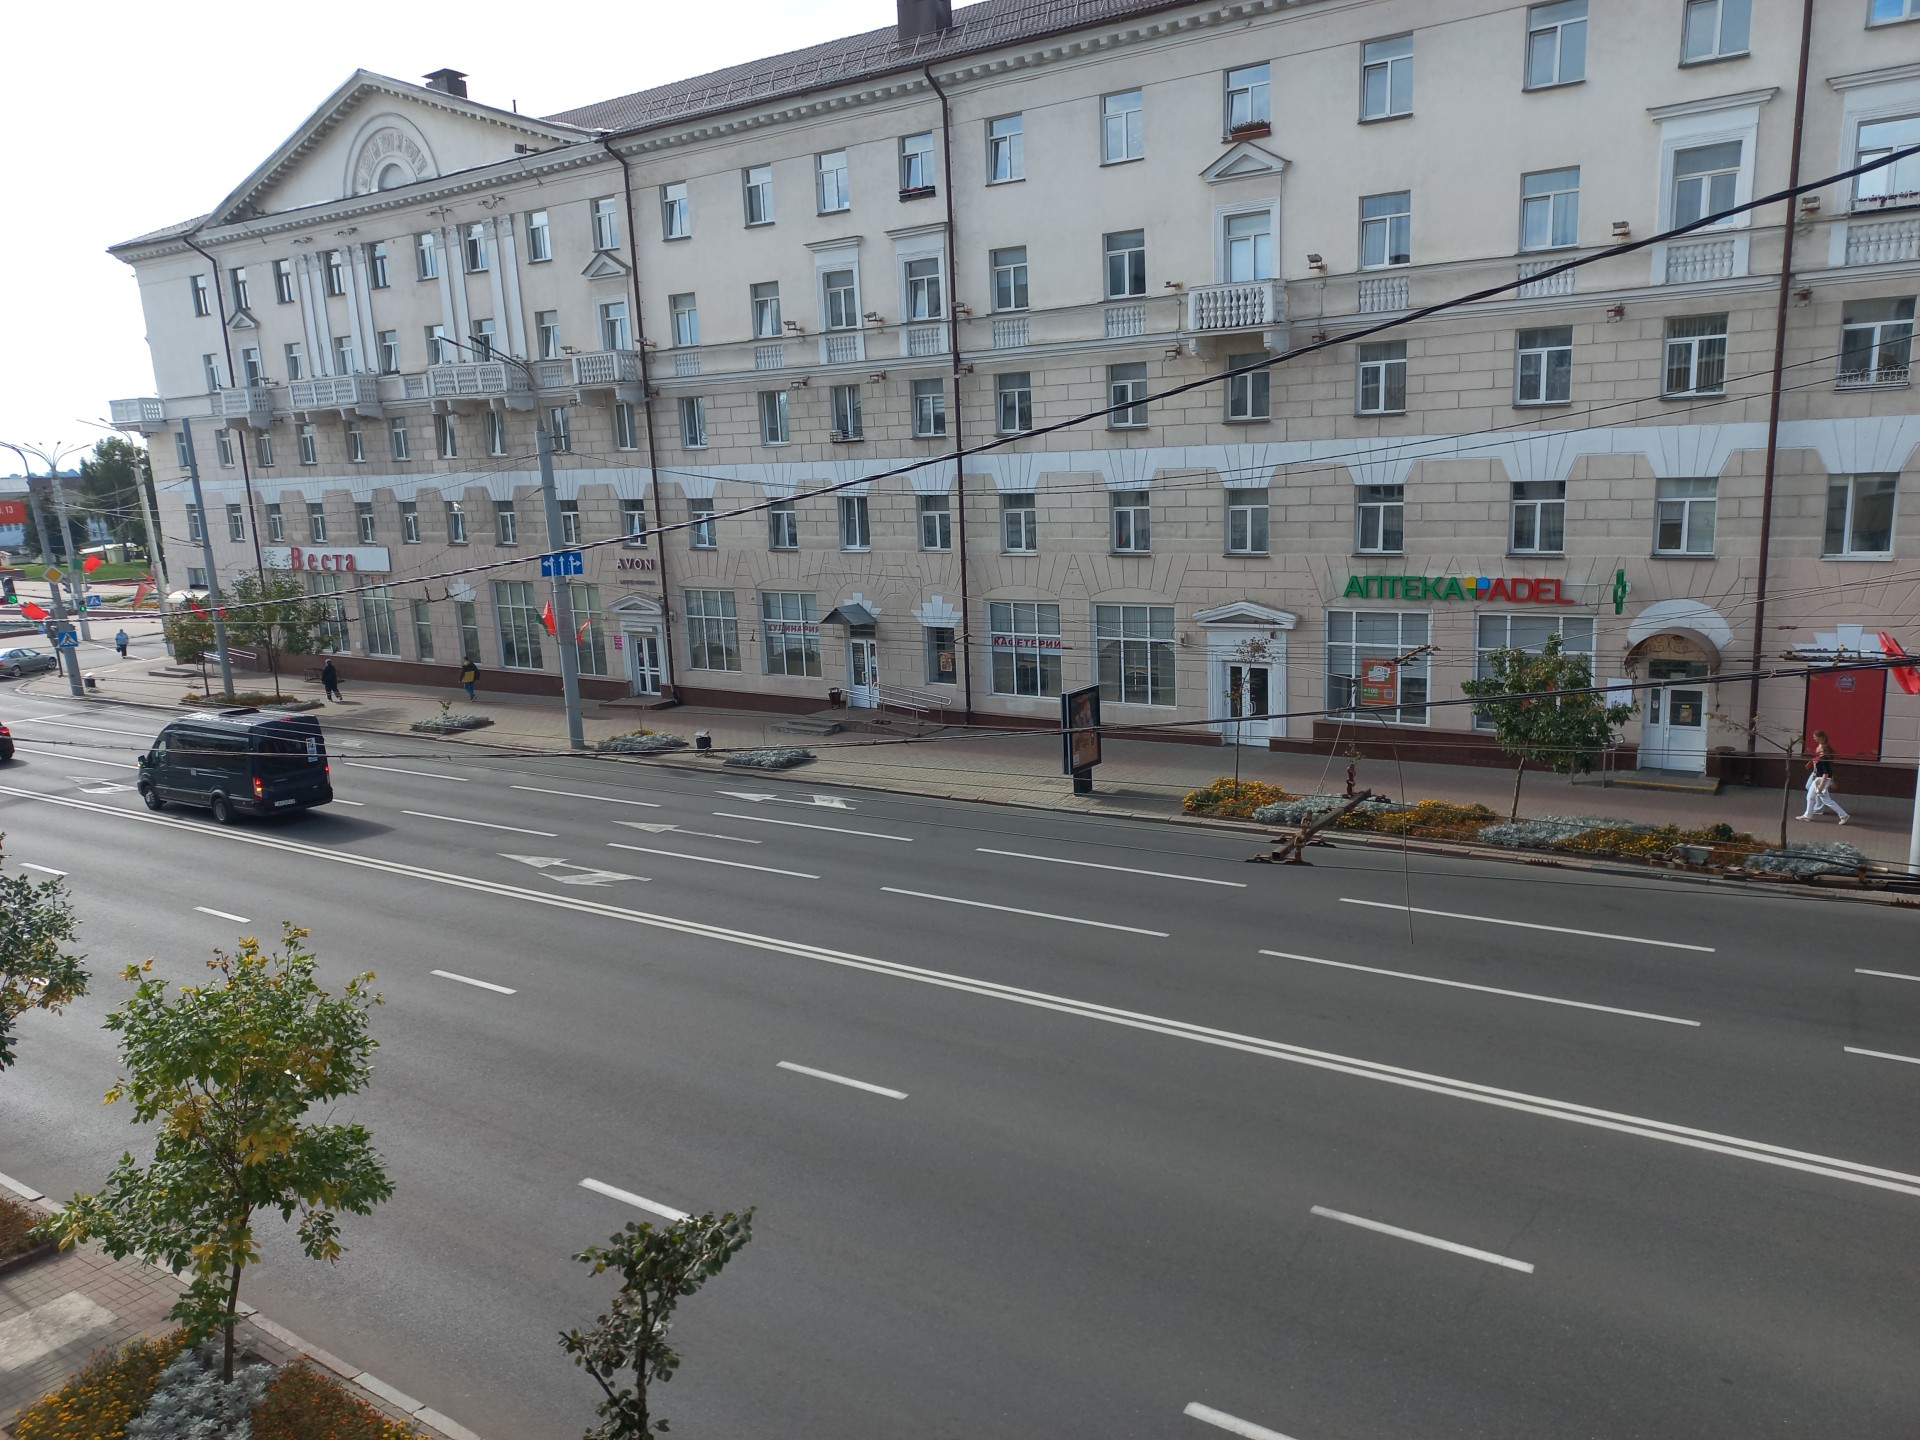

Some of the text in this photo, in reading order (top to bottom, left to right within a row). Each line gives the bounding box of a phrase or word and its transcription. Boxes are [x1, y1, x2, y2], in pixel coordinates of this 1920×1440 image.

[290, 547, 356, 571] Веста
[616, 557, 655, 570] AVON
[1343, 575, 1575, 604] АПТЕКА ADEL
[767, 623, 820, 634] КУЛИНАРИЯ
[993, 637, 1063, 649] КАФЕТЕРИЙ
